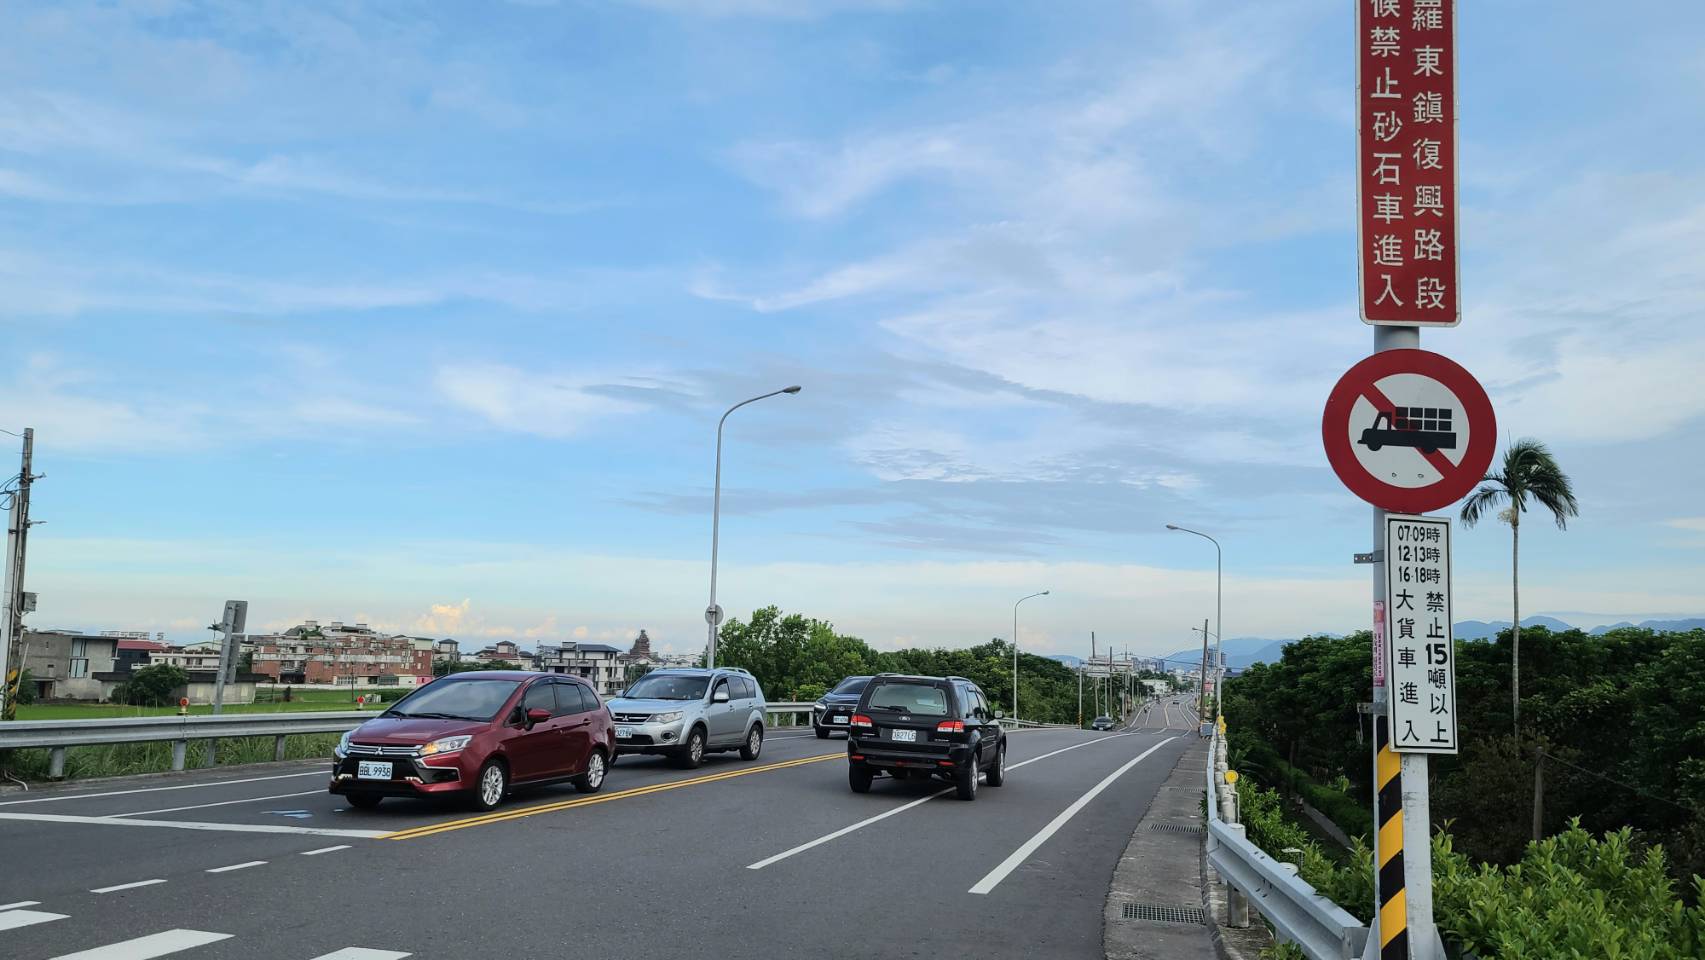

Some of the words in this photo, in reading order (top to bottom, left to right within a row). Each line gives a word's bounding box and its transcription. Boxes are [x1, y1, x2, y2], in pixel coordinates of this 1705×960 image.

[1398, 545, 1441, 563] 12-13時
[1395, 588, 1420, 743] 大貨車進入
